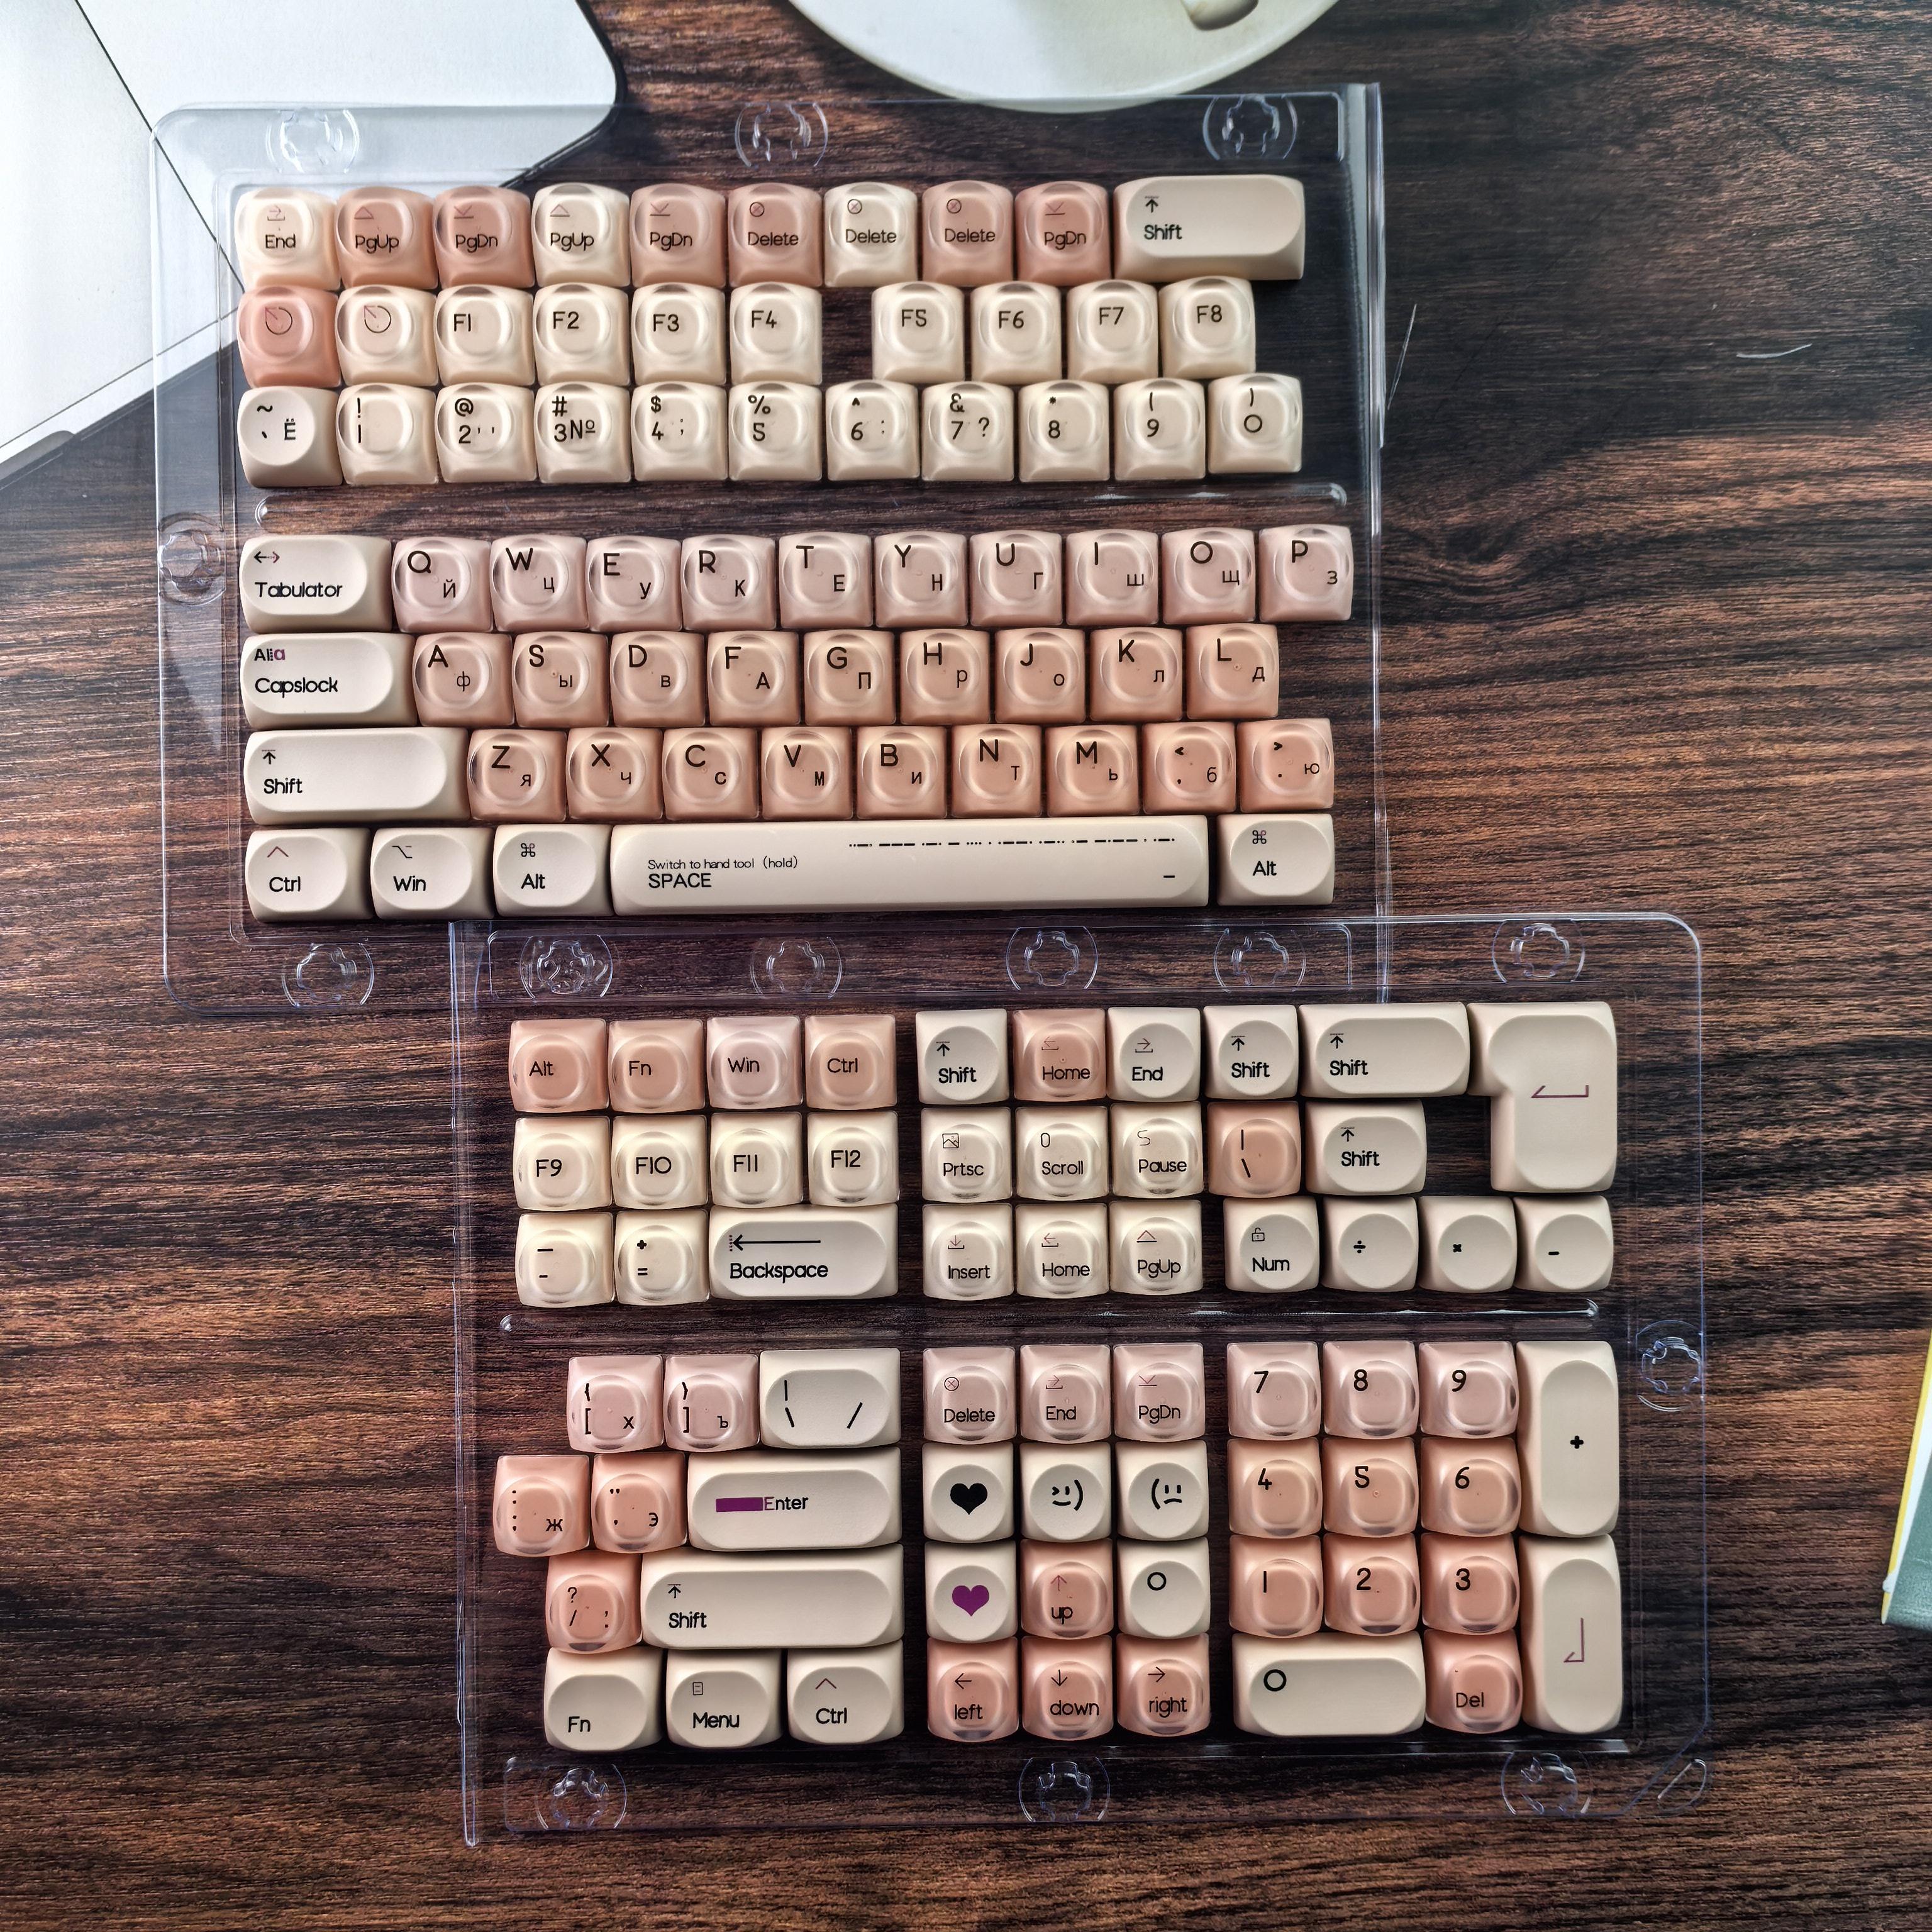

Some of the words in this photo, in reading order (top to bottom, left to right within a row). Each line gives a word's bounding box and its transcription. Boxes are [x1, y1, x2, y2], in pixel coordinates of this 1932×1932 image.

[265, 233, 296, 249] End
[650, 231, 692, 252] PgDn
[748, 231, 799, 247] Delete
[845, 228, 897, 244] Delete
[945, 228, 996, 243] Delete
[1044, 230, 1087, 250] PgDn
[1143, 223, 1183, 240] Shift
[355, 233, 399, 254] PgUp
[455, 233, 498, 253] PgDn
[550, 232, 595, 252] PgUp
[453, 313, 472, 332] F1
[553, 311, 579, 330] F2
[653, 313, 680, 332] F3
[751, 310, 777, 329] F4
[901, 309, 927, 328] F5
[998, 310, 1024, 330] F6
[1099, 306, 1124, 325] F7
[1196, 304, 1223, 324] F8
[454, 397, 474, 418] @
[748, 394, 771, 415] %
[458, 425, 472, 445] 2
[553, 423, 567, 443] 3
[651, 421, 664, 441] 4
[752, 422, 766, 442] 5
[850, 421, 863, 441] 6
[951, 420, 964, 440] 7
[1048, 419, 1061, 440] 8
[1146, 418, 1160, 438] 9
[407, 550, 431, 574] Q
[505, 547, 534, 571] W
[698, 550, 716, 574] R
[796, 545, 814, 569] T
[894, 544, 912, 568] Y
[995, 543, 1015, 567] U
[1291, 540, 1309, 564] P
[603, 552, 621, 576] E
[254, 581, 343, 598] Tabulator
[427, 644, 448, 669] A
[528, 644, 545, 668] S
[628, 644, 648, 668] D
[724, 646, 742, 670] F
[826, 646, 848, 670] G
[923, 641, 942, 665] H
[1019, 643, 1033, 667] J
[1118, 638, 1135, 663] K
[1216, 638, 1232, 662] L
[255, 676, 338, 699] Capslock
[491, 745, 511, 769] Z
[591, 743, 611, 767] X
[685, 744, 706, 768] C
[783, 744, 802, 768] V
[880, 743, 899, 767] B
[979, 738, 999, 762] N
[1075, 741, 1098, 765] M
[264, 777, 303, 794] Shift
[647, 858, 686, 870] Switch
[689, 860, 701, 869] to
[704, 858, 730, 869] hand
[733, 858, 755, 869] tool
[1252, 860, 1277, 877] Alt
[269, 875, 301, 892] Ctrl
[392, 875, 426, 892] Win
[520, 873, 546, 890] Alt
[648, 872, 712, 889] SPACE
[528, 1060, 554, 1077] Alt
[628, 1060, 652, 1077] Fn
[727, 1056, 760, 1073] Win
[827, 1057, 858, 1074] Ctrl
[1042, 1065, 1091, 1080] Home
[1131, 1066, 1163, 1082] End
[1231, 1061, 1270, 1079] Shift
[1330, 1058, 1368, 1076] Shift
[938, 1066, 977, 1084] Shift
[536, 1158, 563, 1177] F9
[635, 1156, 672, 1175] F10
[733, 1154, 758, 1173] F11
[830, 1150, 861, 1169] F12
[1041, 1160, 1084, 1175] Scroll
[1138, 1158, 1187, 1174] Pause
[1341, 1150, 1380, 1167] Shift
[943, 1162, 984, 1177] Prtsc
[730, 1262, 829, 1284] Backspace
[948, 1264, 991, 1280] Insert
[1041, 1262, 1091, 1277] Home
[1137, 1258, 1182, 1279] PgUp
[1252, 1257, 1290, 1272] Num
[1253, 1370, 1269, 1394] 7
[1353, 1368, 1368, 1392] 8
[1452, 1369, 1467, 1392] 9
[943, 1407, 996, 1423] Delete
[1046, 1406, 1077, 1421] End
[1138, 1404, 1181, 1424] PgDn
[1257, 1467, 1273, 1491] 4
[1354, 1465, 1370, 1489] 5
[1455, 1466, 1470, 1489] 6
[763, 1496, 809, 1511] Enter
[1356, 1567, 1372, 1591] 2
[1455, 1568, 1471, 1591] 3
[669, 1611, 708, 1629] Shift
[1051, 1606, 1074, 1625] up
[1050, 1699, 1099, 1716] down
[1148, 1696, 1188, 1719] right
[1455, 1691, 1484, 1708] Del
[692, 1711, 740, 1729] Menu
[816, 1707, 848, 1724] Ctrl
[954, 1703, 984, 1721] left
[567, 1716, 591, 1733] Fn
